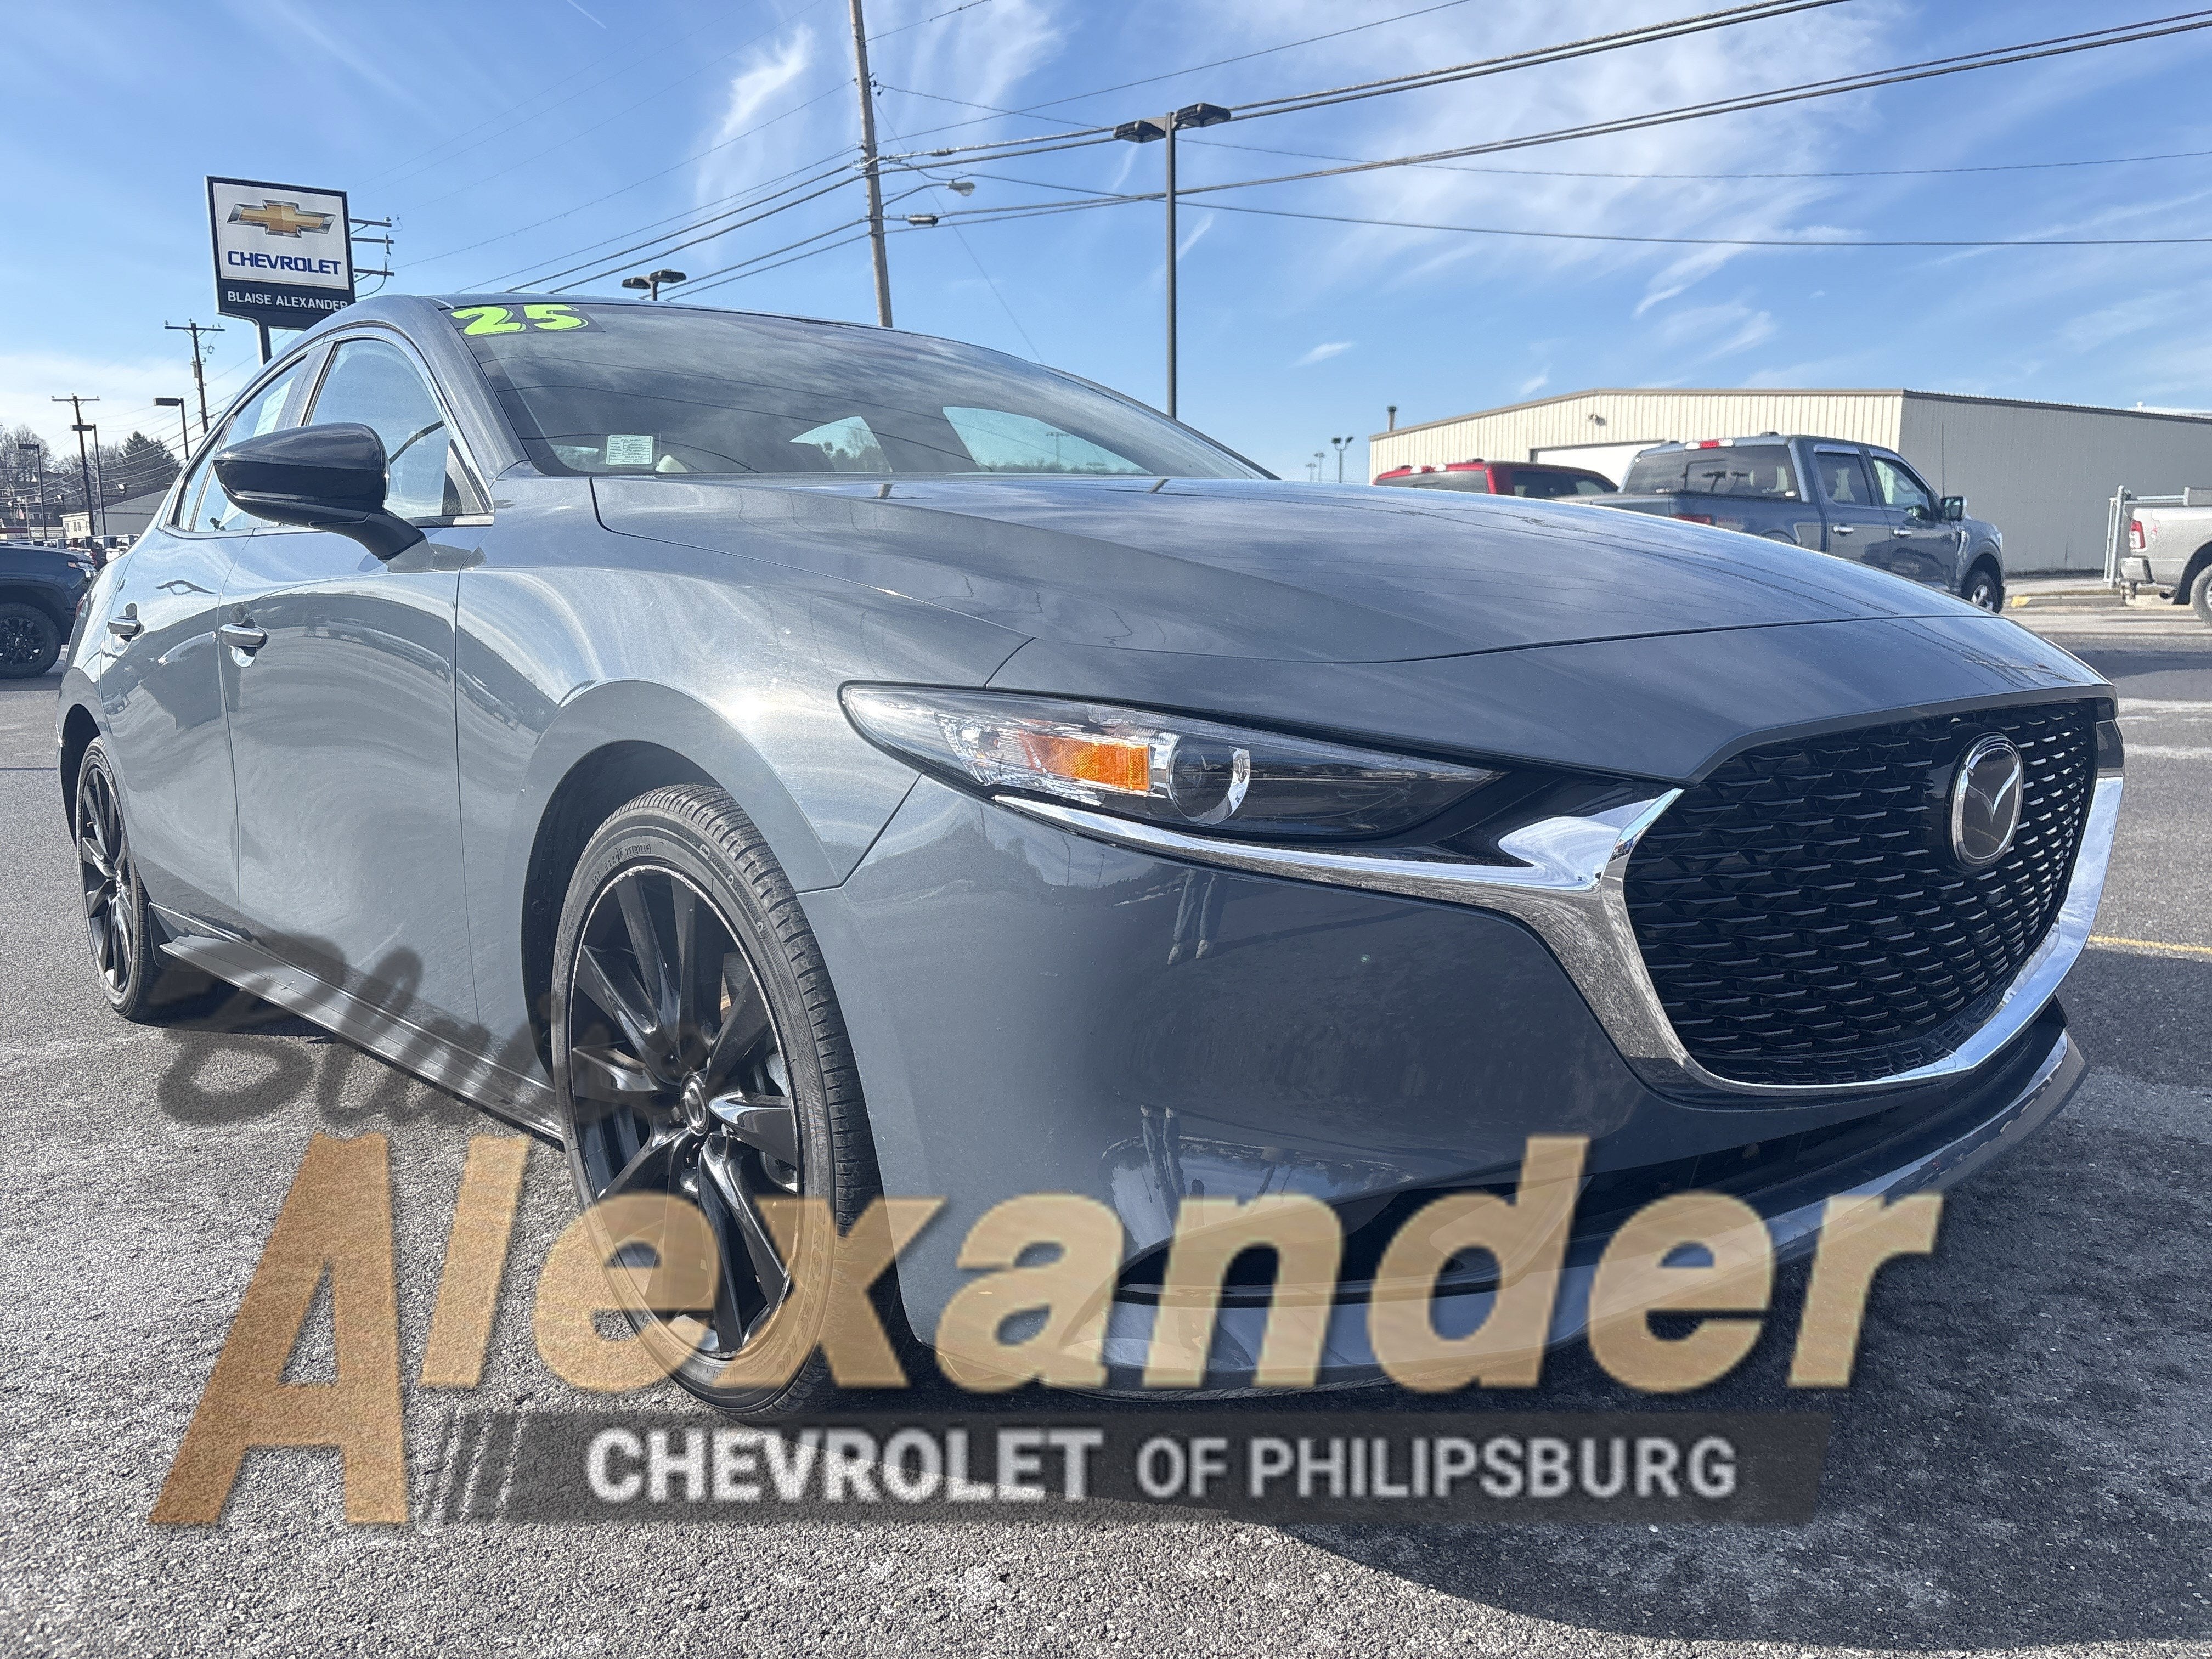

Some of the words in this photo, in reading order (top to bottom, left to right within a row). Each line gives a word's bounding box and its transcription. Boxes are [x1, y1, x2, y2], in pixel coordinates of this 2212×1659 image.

[227, 250, 341, 275] CHEVROLET
[227, 291, 273, 306] BLAISE
[275, 295, 348, 312] ALEXANDER
[450, 304, 589, 335] 25
